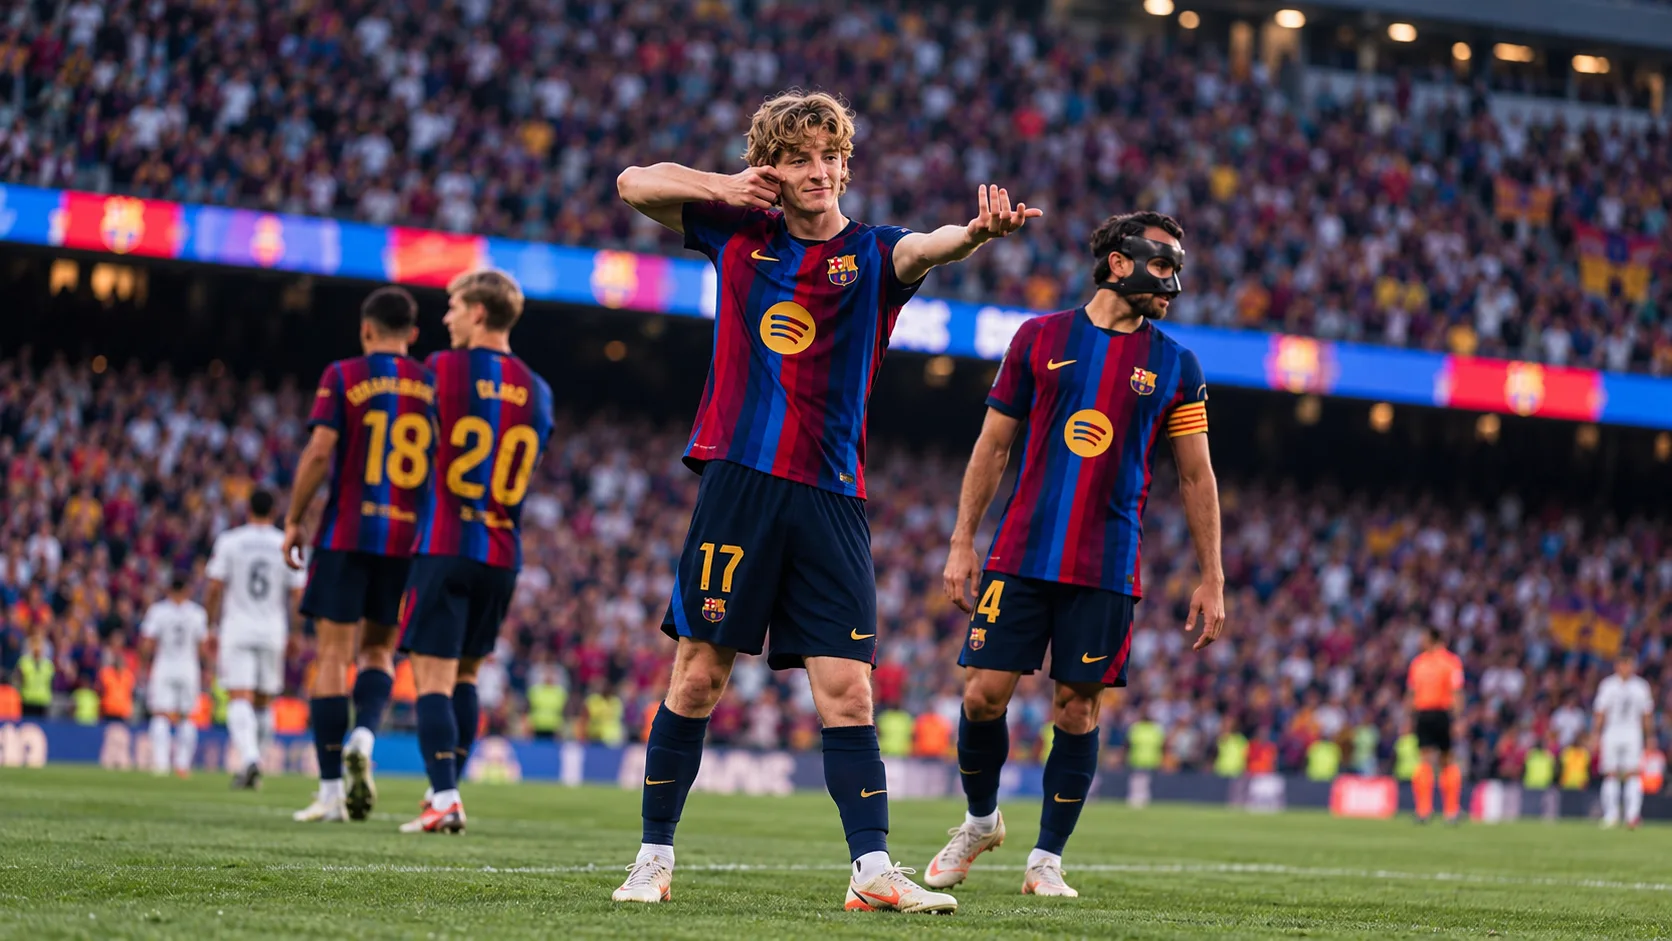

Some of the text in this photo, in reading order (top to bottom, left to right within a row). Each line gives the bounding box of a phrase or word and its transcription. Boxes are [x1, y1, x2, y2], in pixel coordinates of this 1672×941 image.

[362, 409, 432, 489] 18
[446, 416, 540, 507] 20
[249, 556, 270, 600] 6
[700, 542, 744, 593] 17
